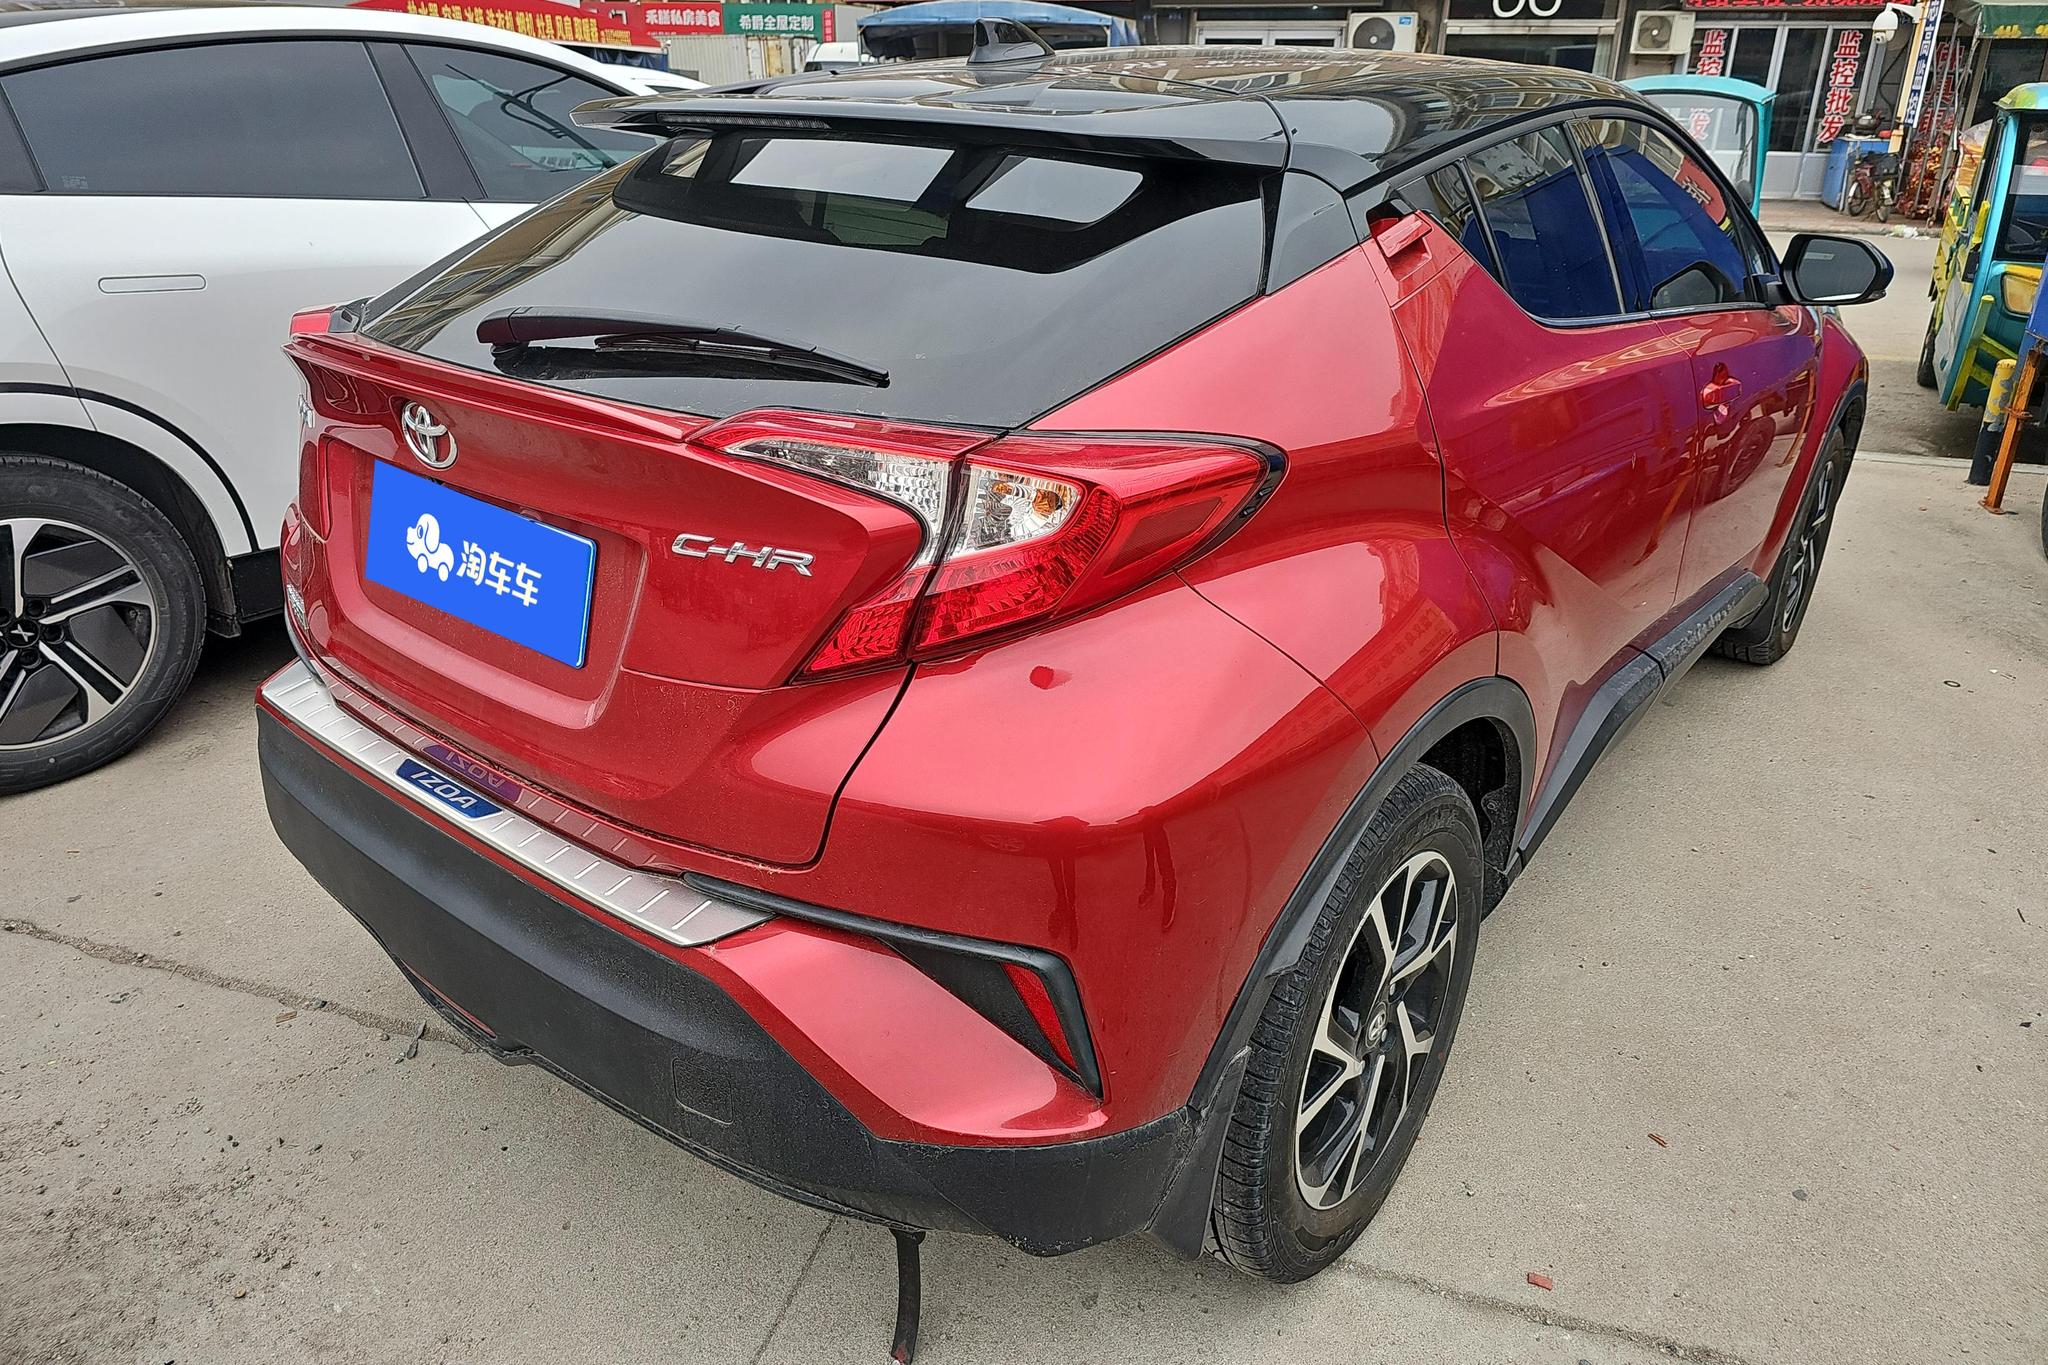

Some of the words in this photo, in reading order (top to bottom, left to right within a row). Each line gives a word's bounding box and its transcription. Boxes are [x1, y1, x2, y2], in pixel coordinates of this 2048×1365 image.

[1817, 30, 1863, 143] 监控批发
[671, 533, 814, 577] C-HR
[410, 771, 478, 809] IZOA
